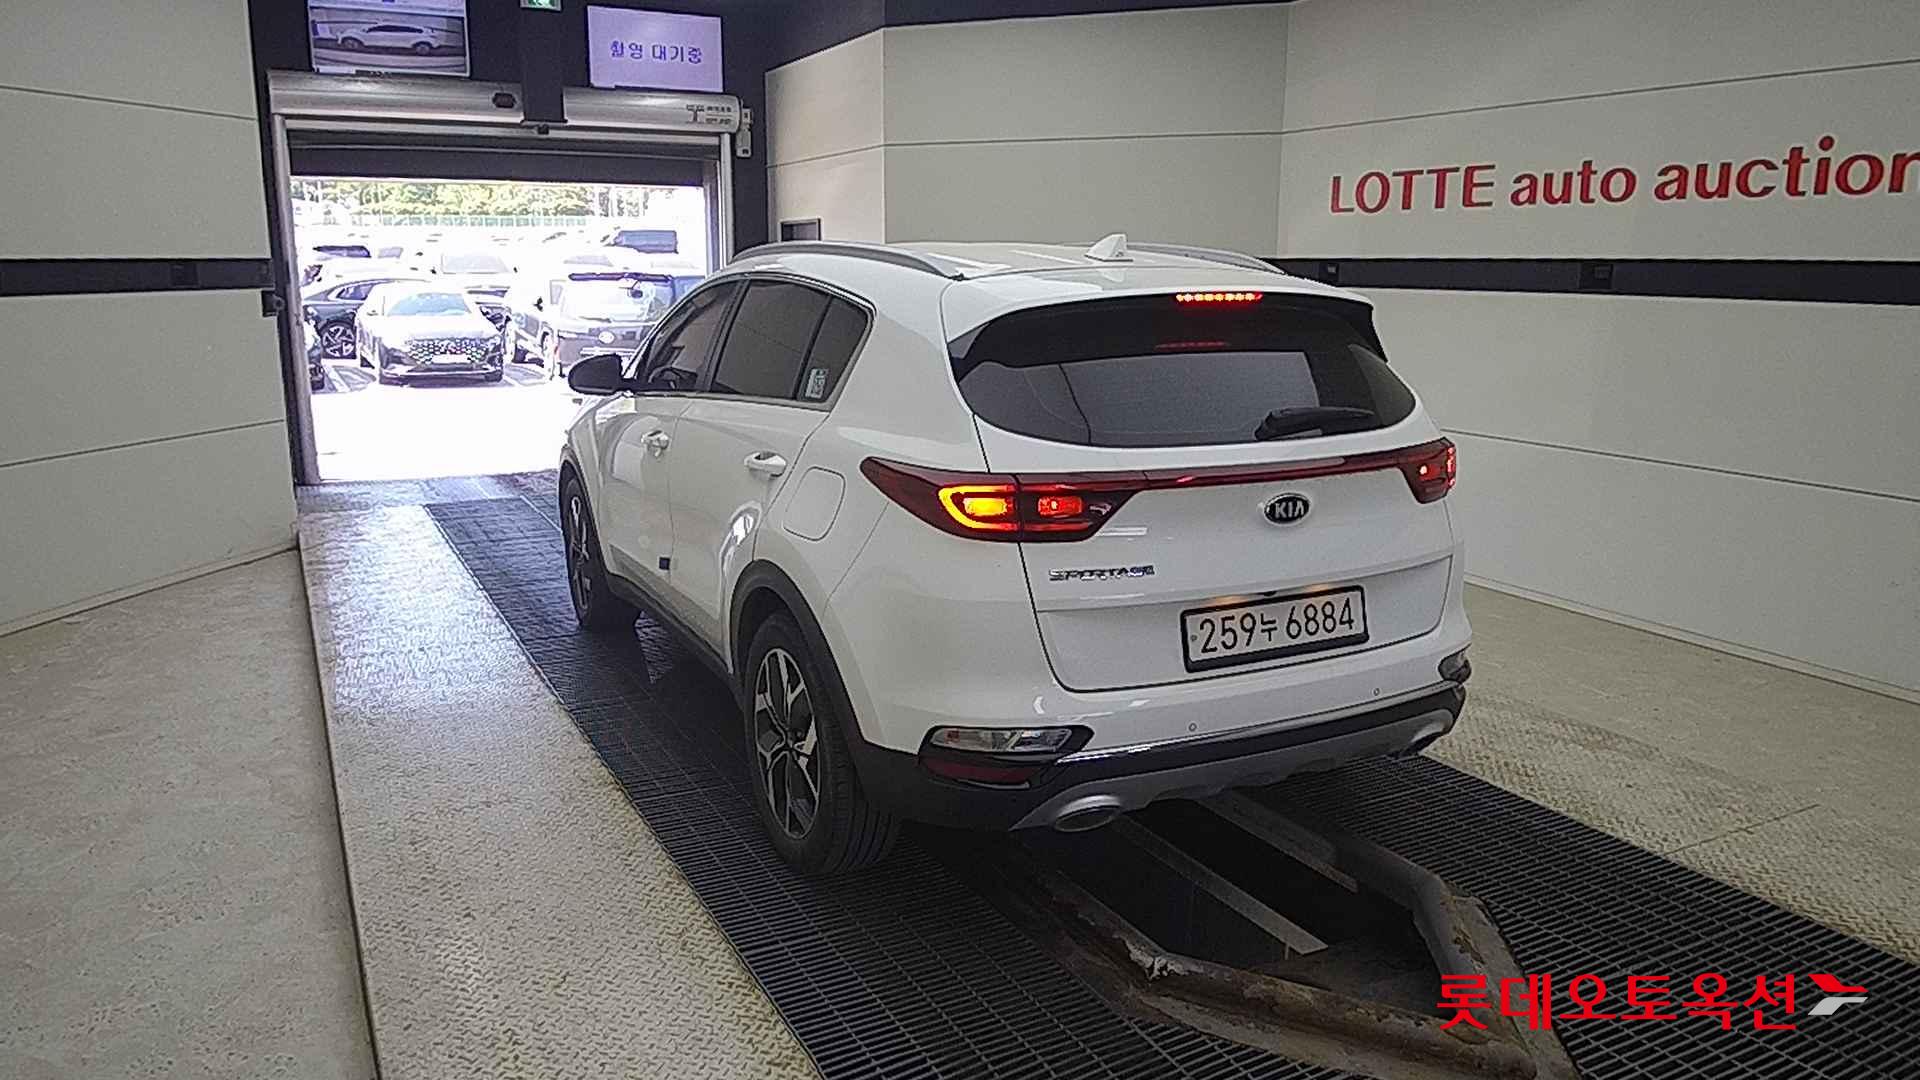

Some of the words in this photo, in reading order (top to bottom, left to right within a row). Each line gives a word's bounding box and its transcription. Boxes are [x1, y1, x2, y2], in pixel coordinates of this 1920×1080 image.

[1329, 163, 1496, 213] LOTTE
[1510, 159, 1637, 206] auto
[1275, 500, 1305, 518] KIA
